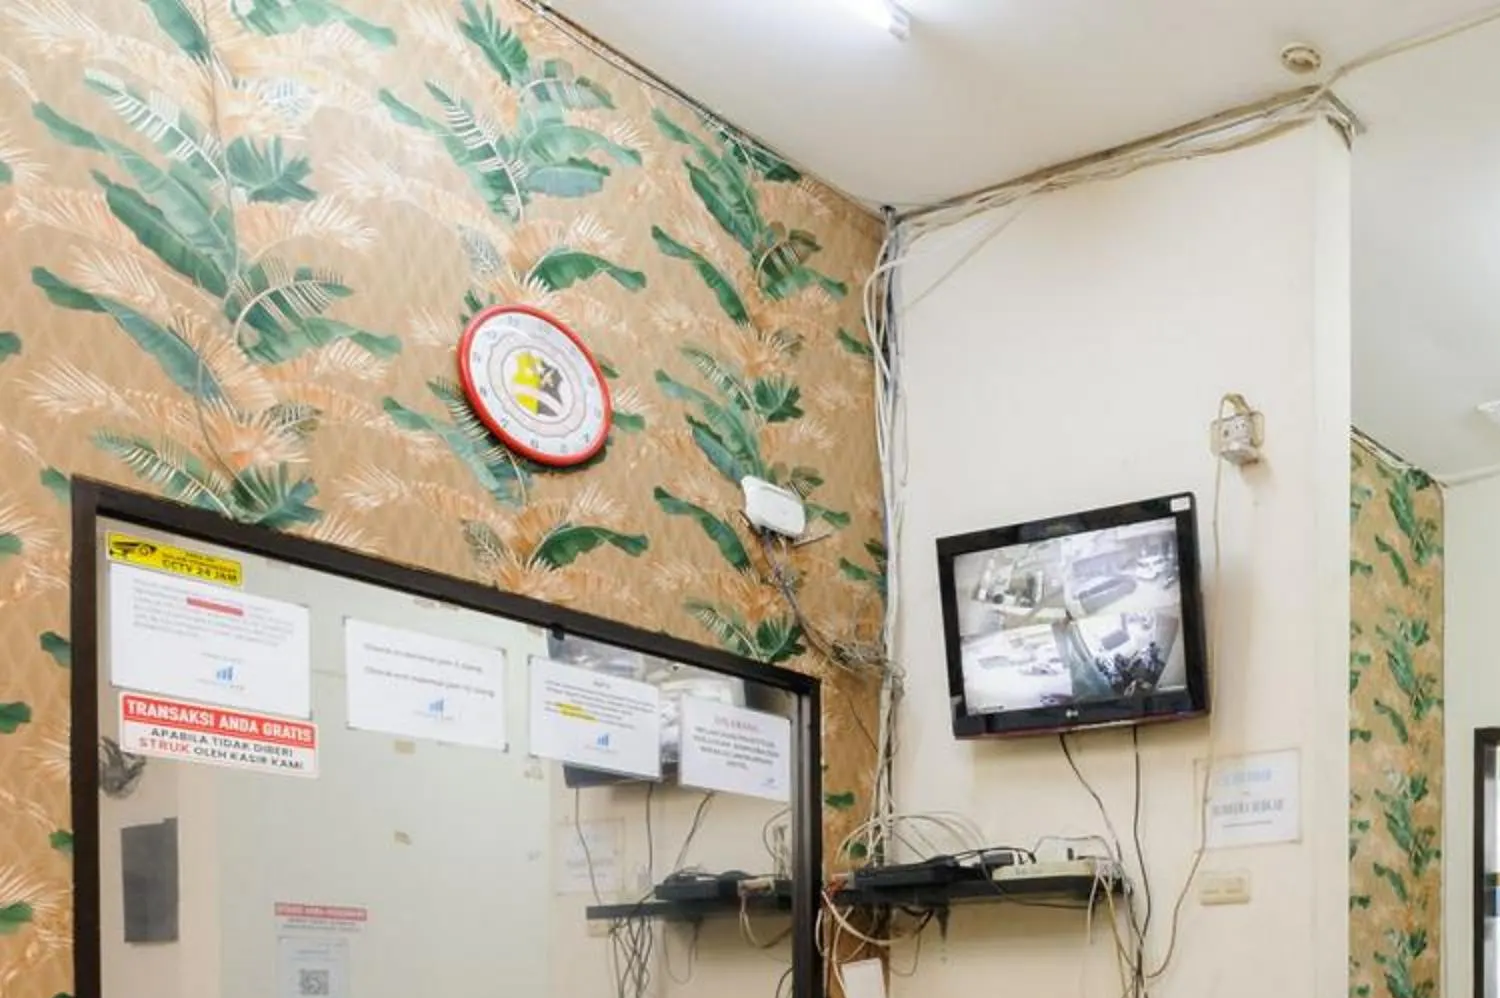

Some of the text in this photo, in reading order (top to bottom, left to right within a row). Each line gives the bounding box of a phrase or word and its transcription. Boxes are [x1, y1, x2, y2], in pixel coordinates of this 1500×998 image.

[127, 700, 312, 742] TRANSAKSI ANDA GRATIS
[139, 737, 189, 754] STRUK
[193, 747, 227, 760] OLEH
[151, 728, 293, 757] APABILA TIDAK DIBERI
